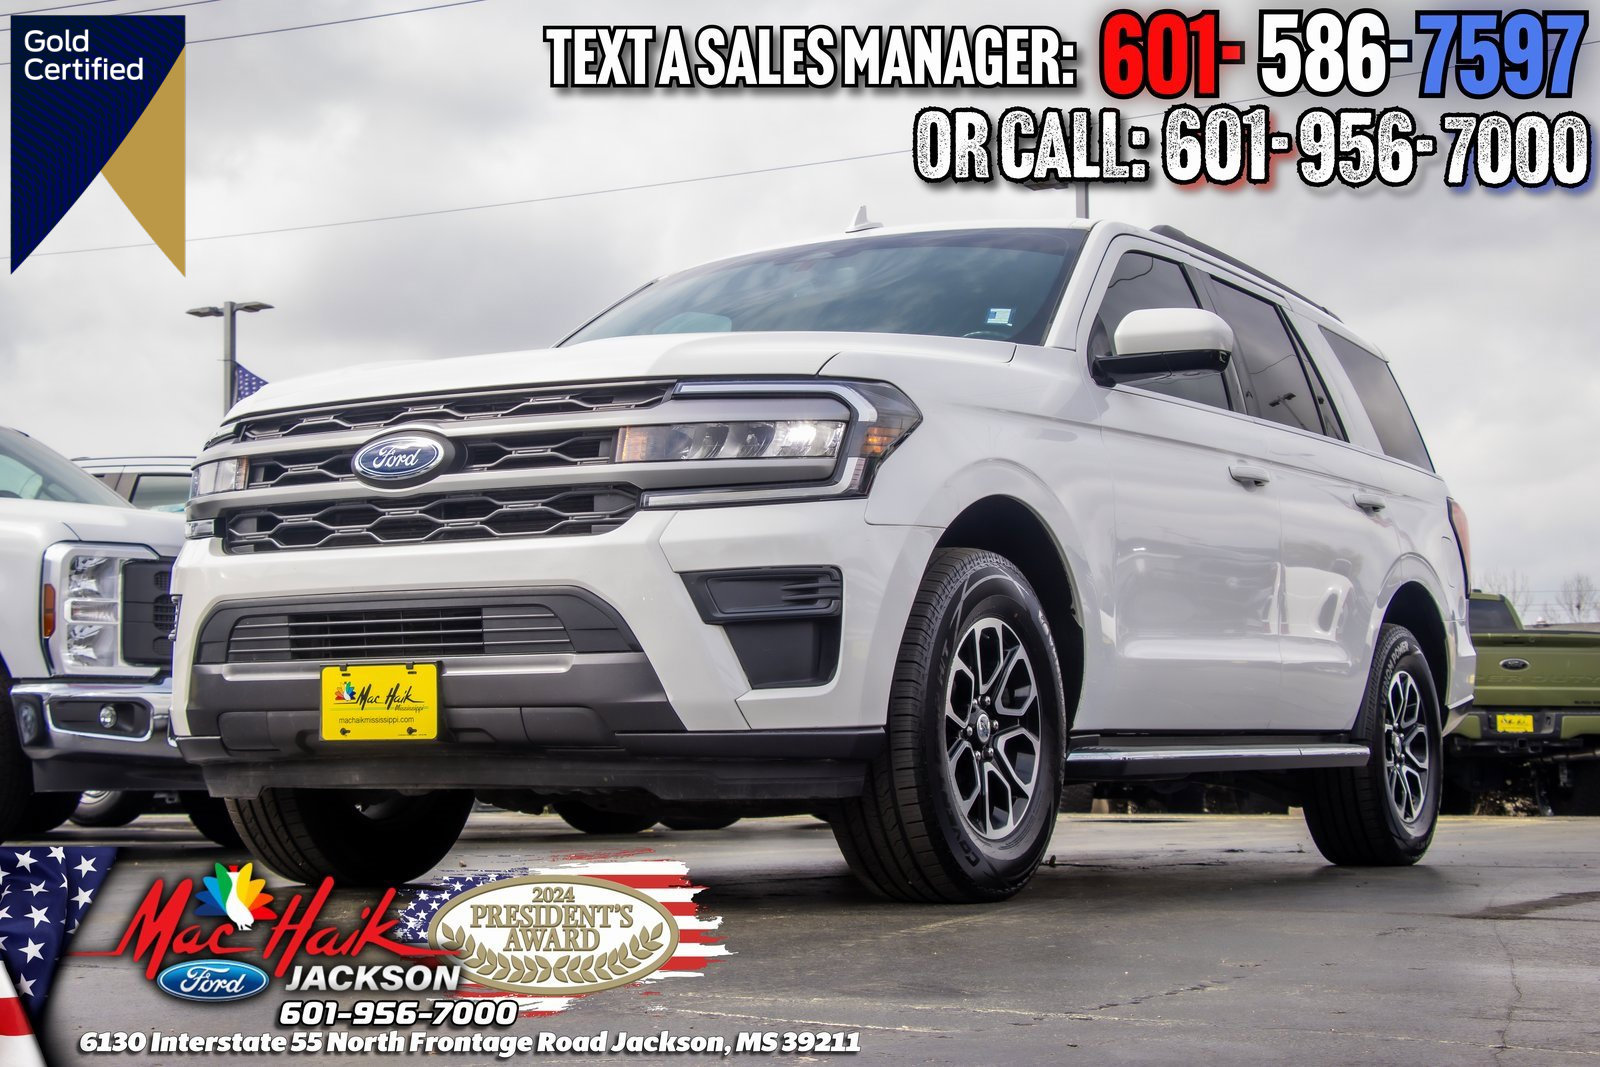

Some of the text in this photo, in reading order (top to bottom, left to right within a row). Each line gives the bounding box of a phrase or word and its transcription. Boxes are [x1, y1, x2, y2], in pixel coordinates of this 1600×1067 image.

[372, 445, 421, 469] Ford
[354, 683, 425, 711] Mac Haik
[338, 715, 414, 725] machaikmississippi.com
